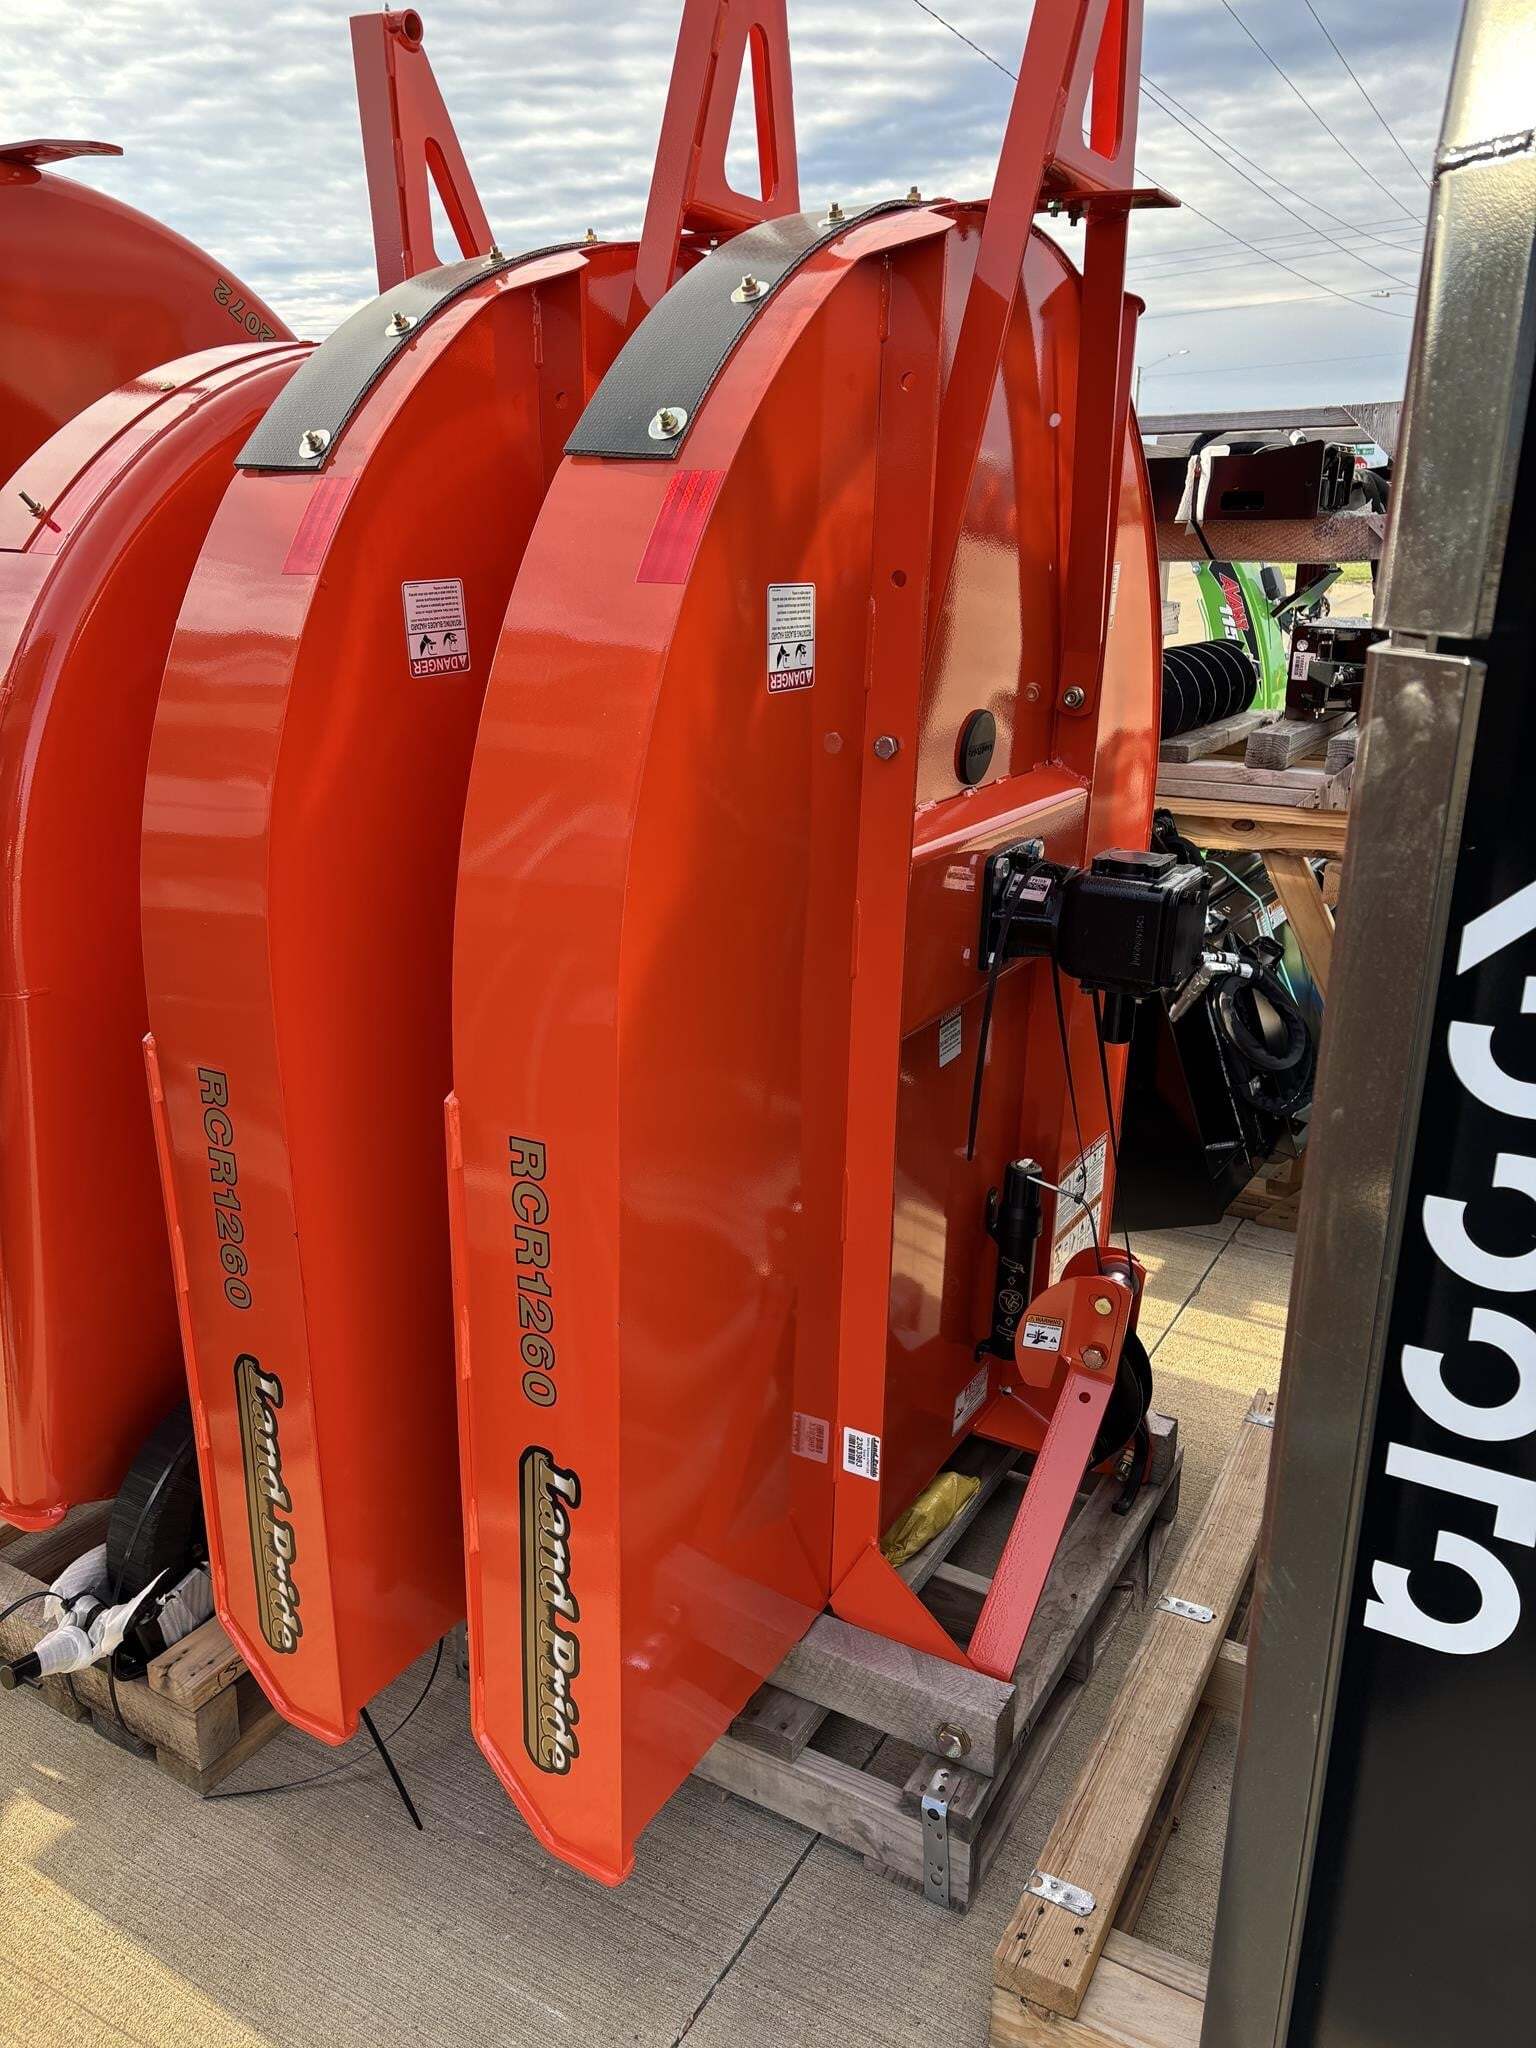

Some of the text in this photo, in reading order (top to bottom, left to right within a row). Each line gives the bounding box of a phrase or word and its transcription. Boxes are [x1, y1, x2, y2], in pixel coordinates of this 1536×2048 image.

[214, 279, 277, 342] 2072
[413, 656, 458, 674] DANGER
[770, 670, 805, 689] DANGER
[198, 1067, 252, 1310] RCR1260
[509, 1136, 558, 1408] RCR1260
[249, 1362, 303, 1650] Land Pride
[872, 1437, 880, 1458] Land
[538, 1456, 580, 1770] Land Pride
